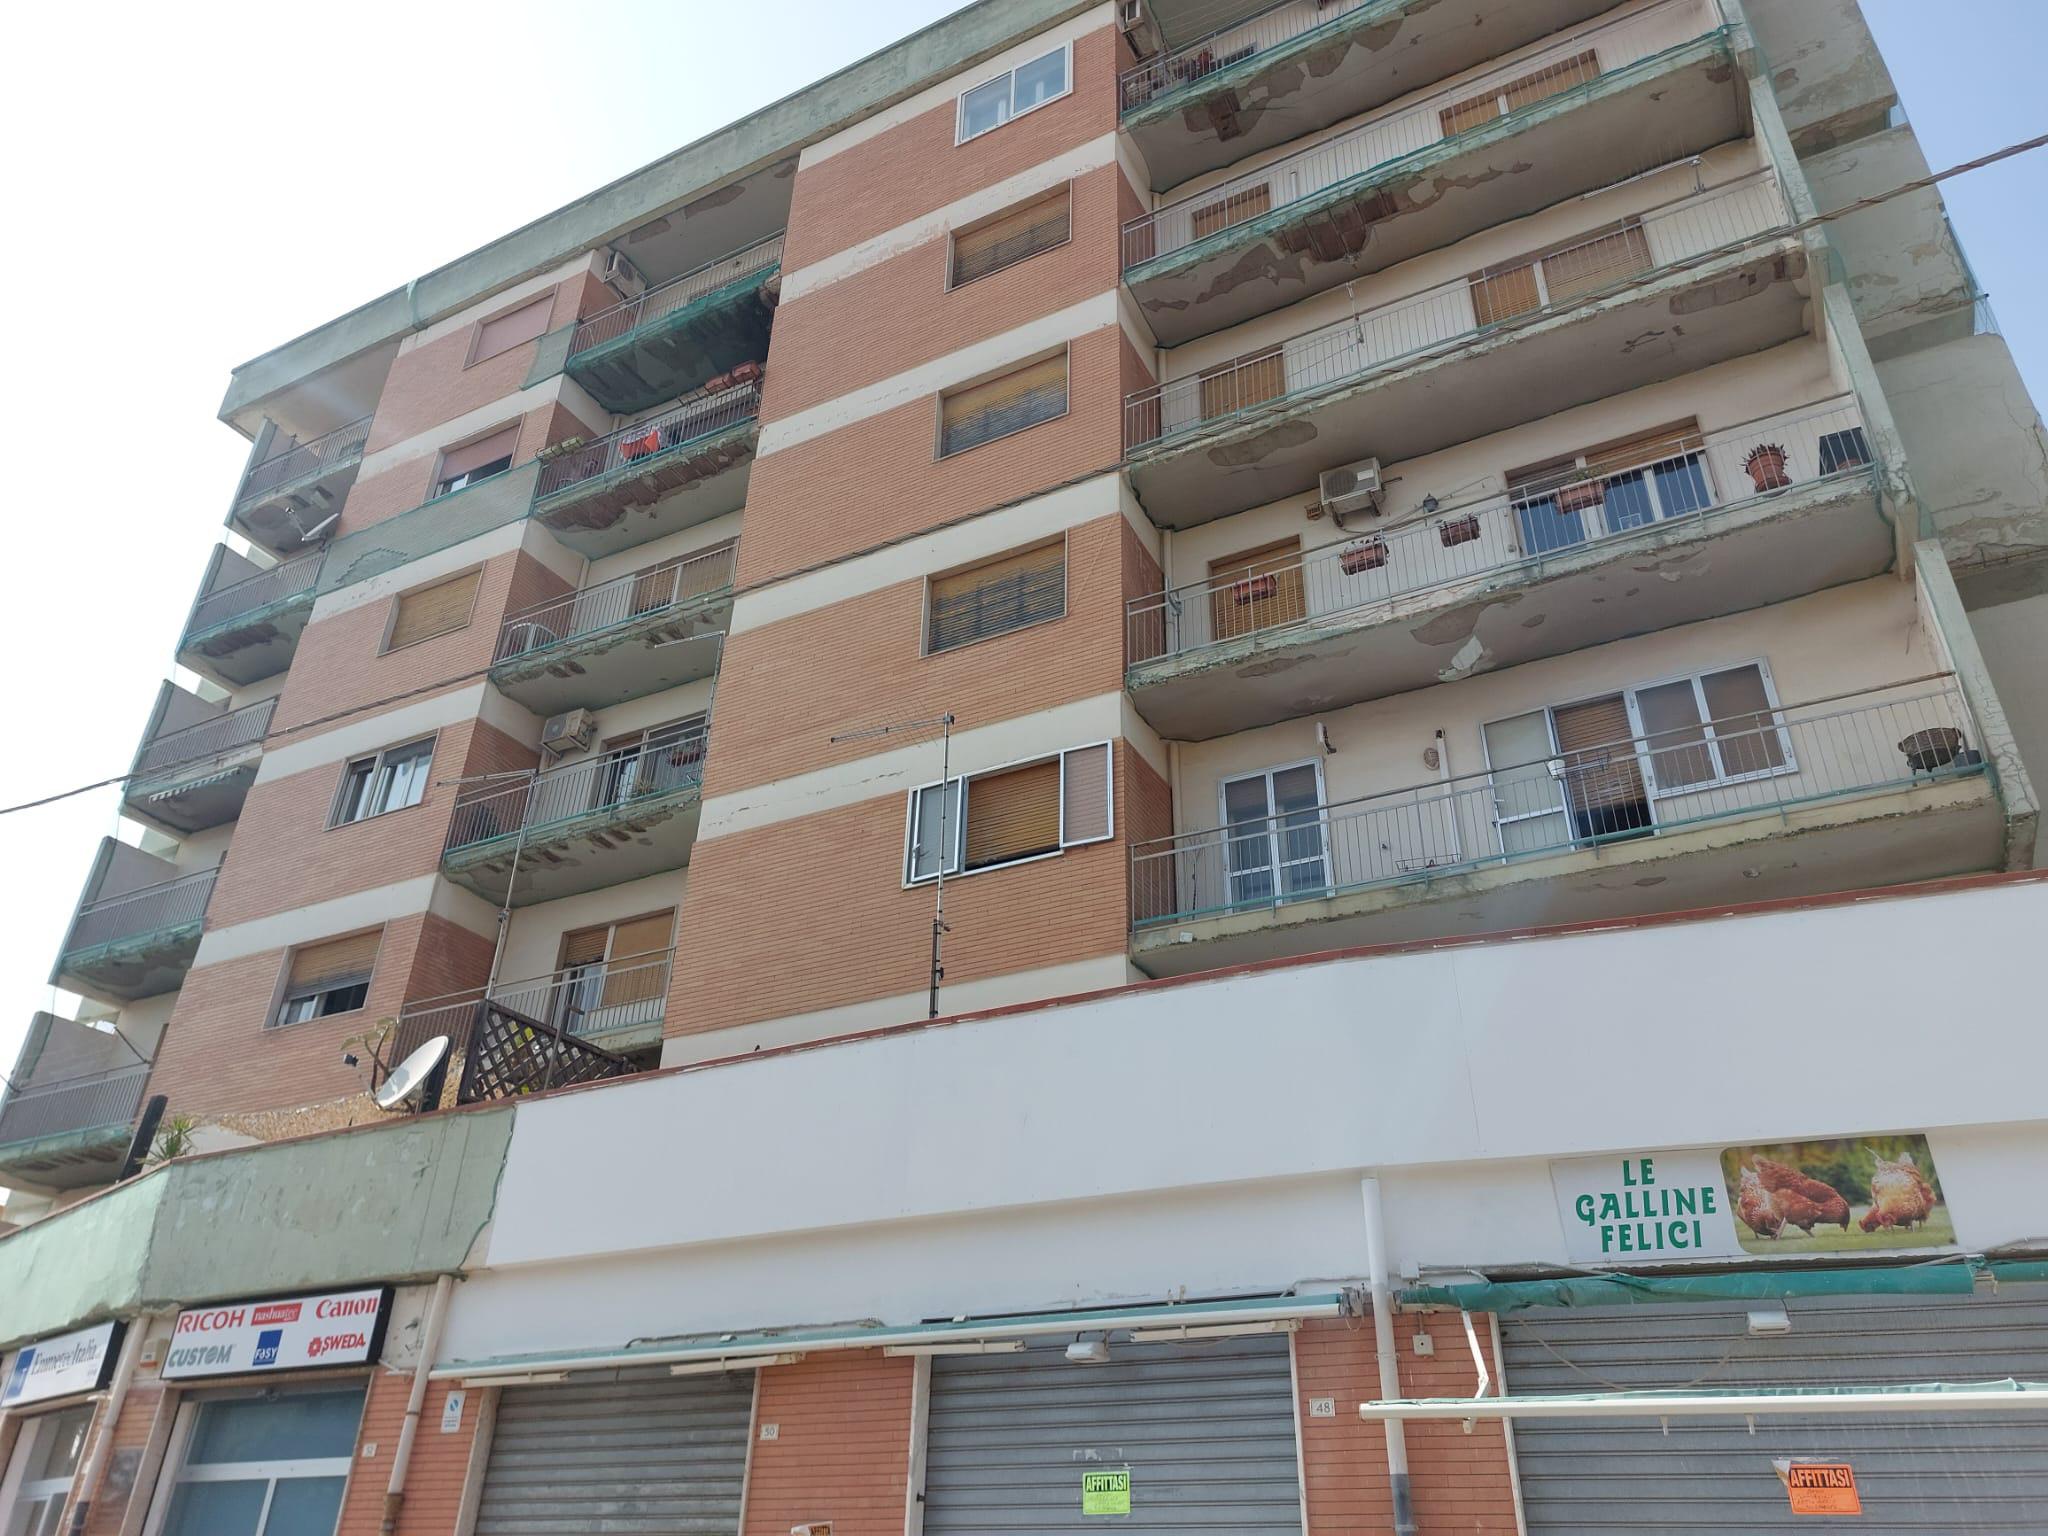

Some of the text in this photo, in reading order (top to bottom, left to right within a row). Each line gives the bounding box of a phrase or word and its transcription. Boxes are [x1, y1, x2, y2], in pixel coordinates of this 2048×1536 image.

[1622, 1158, 1655, 1187] LE
[1575, 1186, 1717, 1227] GALLINE
[1600, 1220, 1702, 1253] FELICI
[315, 1297, 378, 1319] Canon
[177, 1308, 246, 1334] RICOH
[168, 1343, 234, 1368] CUSTOM
[321, 1332, 366, 1355] SWEDA
[1316, 1401, 1331, 1414] 48
[1086, 1474, 1127, 1492] AFFITTASI
[1791, 1468, 1851, 1488] AFFITTASI
